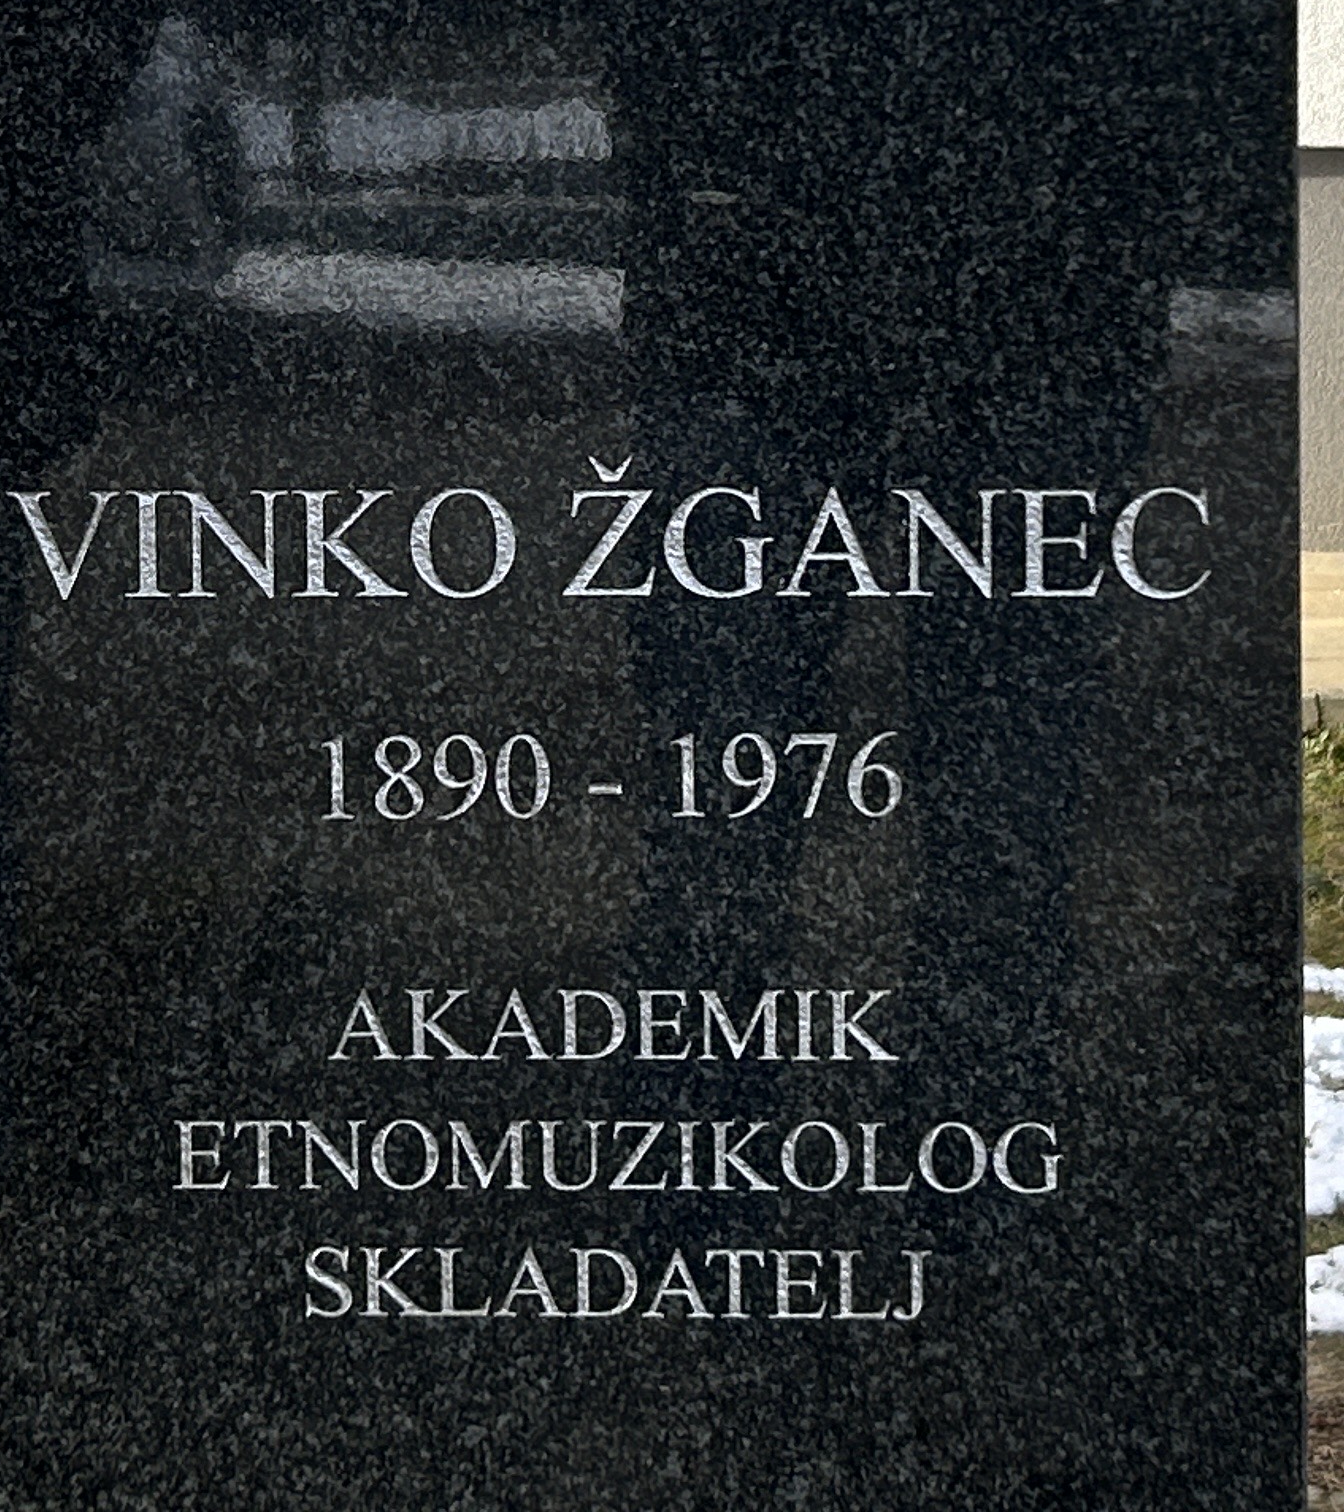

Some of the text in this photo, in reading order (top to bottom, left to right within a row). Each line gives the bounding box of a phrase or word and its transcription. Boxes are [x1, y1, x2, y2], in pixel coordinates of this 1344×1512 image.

[6, 455, 1212, 601] VINKO ŽGANEC
[320, 734, 552, 821] 1890
[670, 731, 903, 820] 1976
[327, 988, 900, 1062] AKADEMIK
[172, 1118, 1064, 1194] ETNOMUZIKOLOG
[304, 1245, 930, 1322] SKLADATELJ
